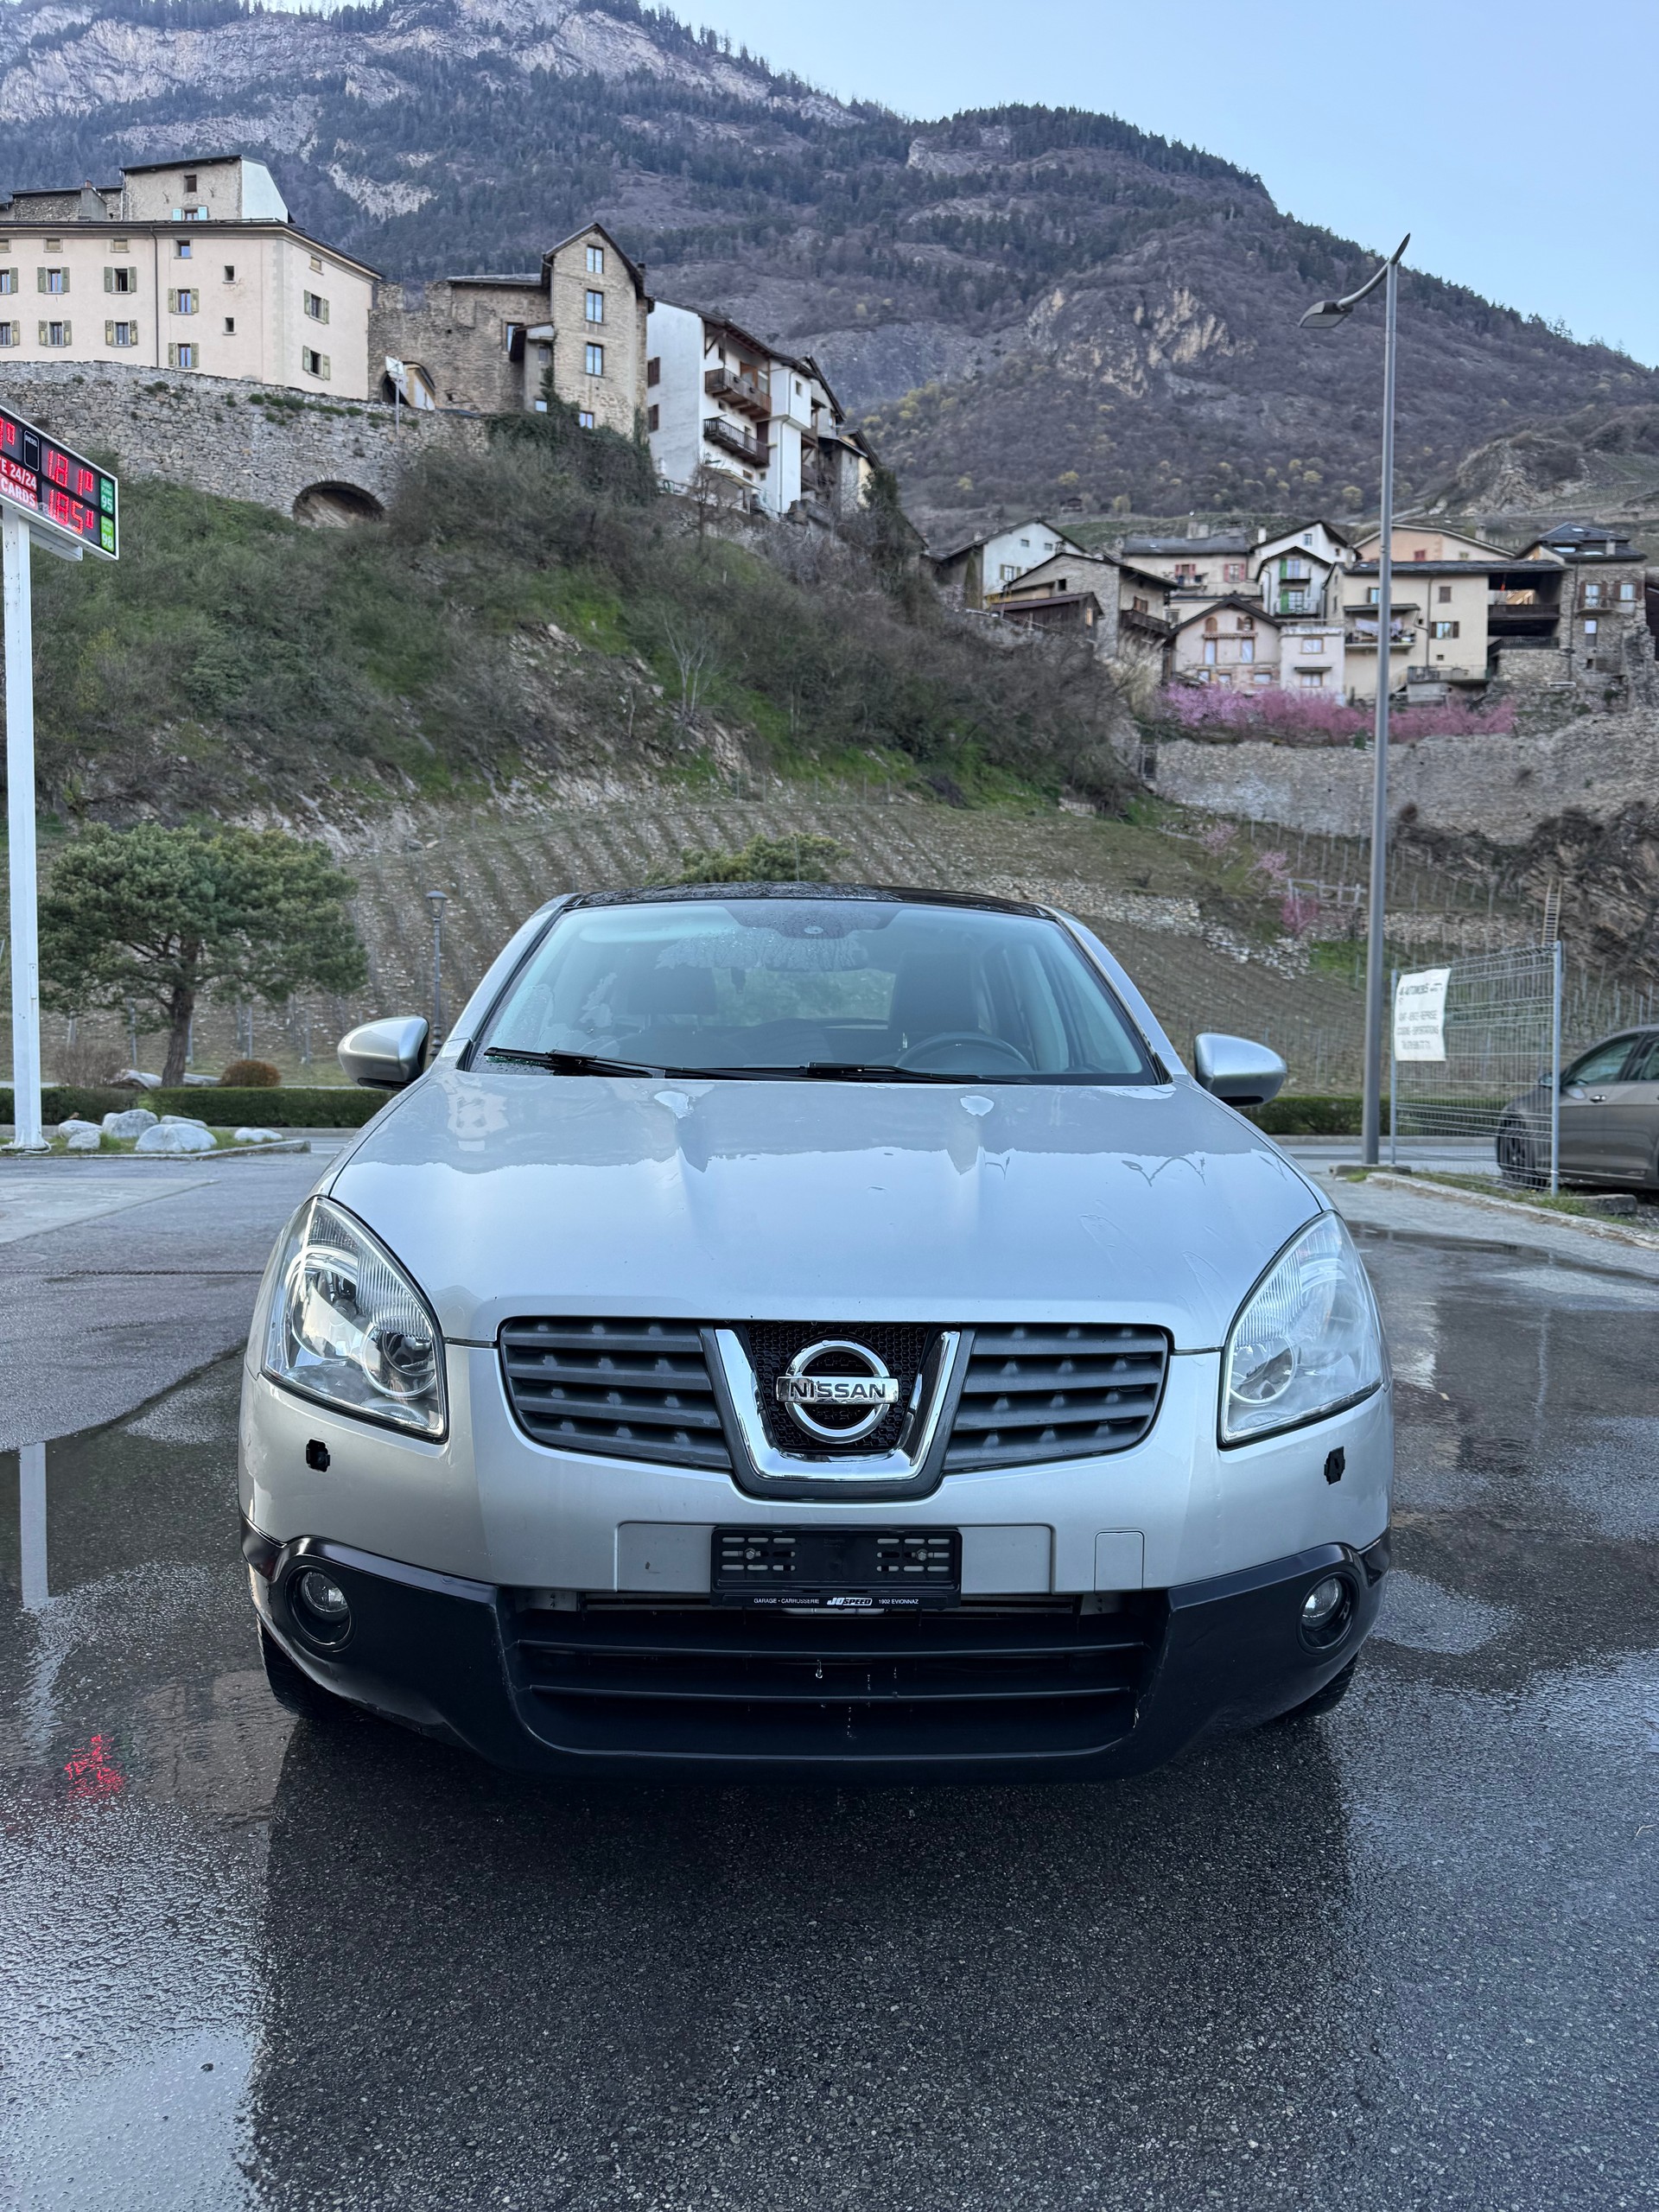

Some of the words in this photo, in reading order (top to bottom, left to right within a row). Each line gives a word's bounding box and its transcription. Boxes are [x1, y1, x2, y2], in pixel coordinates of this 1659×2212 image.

[25, 435, 38, 448] DIESEL
[0, 456, 8, 474] E
[10, 463, 37, 491] 24/24
[1, 477, 36, 507] CARDS
[101, 495, 113, 512] 95
[101, 532, 113, 550] 98
[790, 1382, 886, 1398] NISSAN
